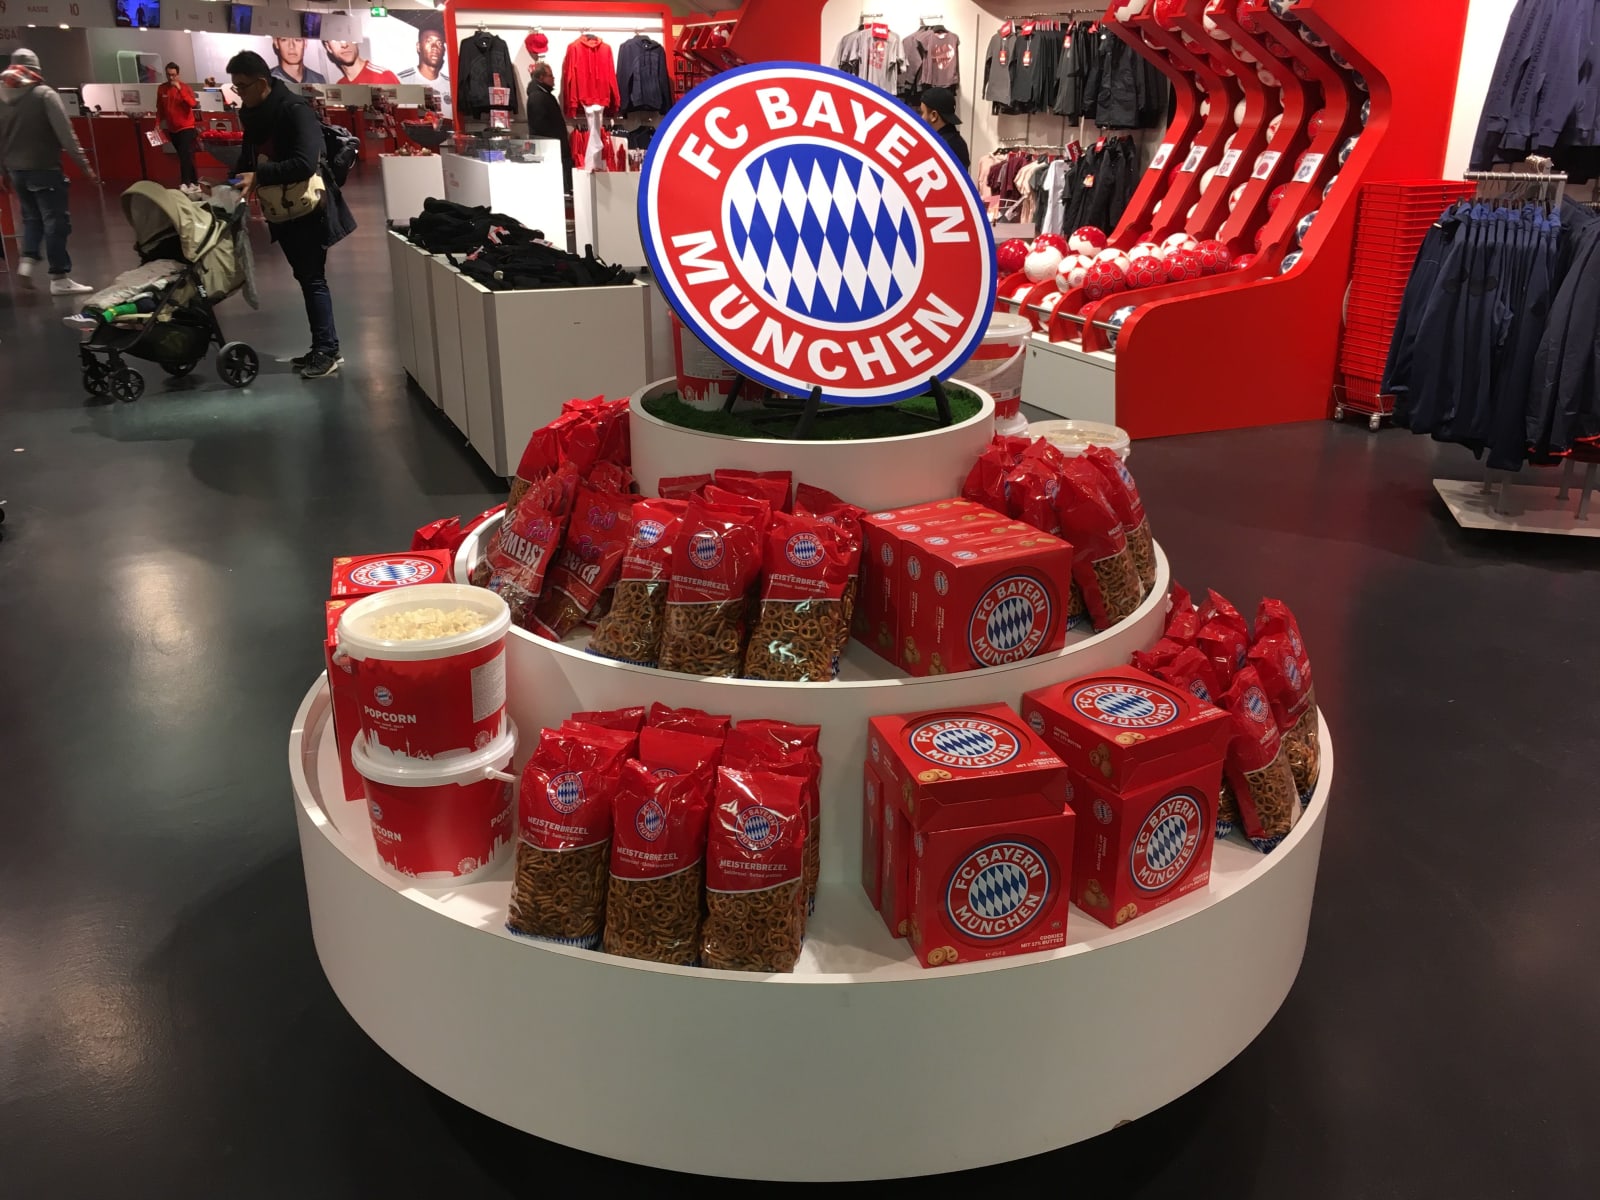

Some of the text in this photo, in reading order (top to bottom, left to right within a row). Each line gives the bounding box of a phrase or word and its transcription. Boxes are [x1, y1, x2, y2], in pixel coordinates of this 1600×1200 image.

[678, 87, 970, 243] FC BAYERN
[671, 229, 964, 381] MÜNCHEN
[976, 581, 1046, 620] FC BAYERN
[974, 629, 1041, 664] MÜNCHEN
[1079, 686, 1153, 709] FC BAYERN
[364, 705, 416, 724] POPCORN
[1098, 703, 1172, 726] MÜNCHEN
[917, 721, 1003, 743] FC BAYERN
[925, 743, 1013, 766] MÜNCHEN
[527, 815, 589, 835] MEISTERBREZEL
[1136, 832, 1150, 854] FC
[1149, 800, 1196, 828] BAYERN
[616, 846, 679, 862] MEISTERBREZEL
[719, 859, 788, 871] MEISTERBREZEL
[1138, 834, 1196, 884] MÜNCHEN
[955, 848, 1042, 890] FC BAYERN
[955, 894, 1041, 933] MÜNCHEN
